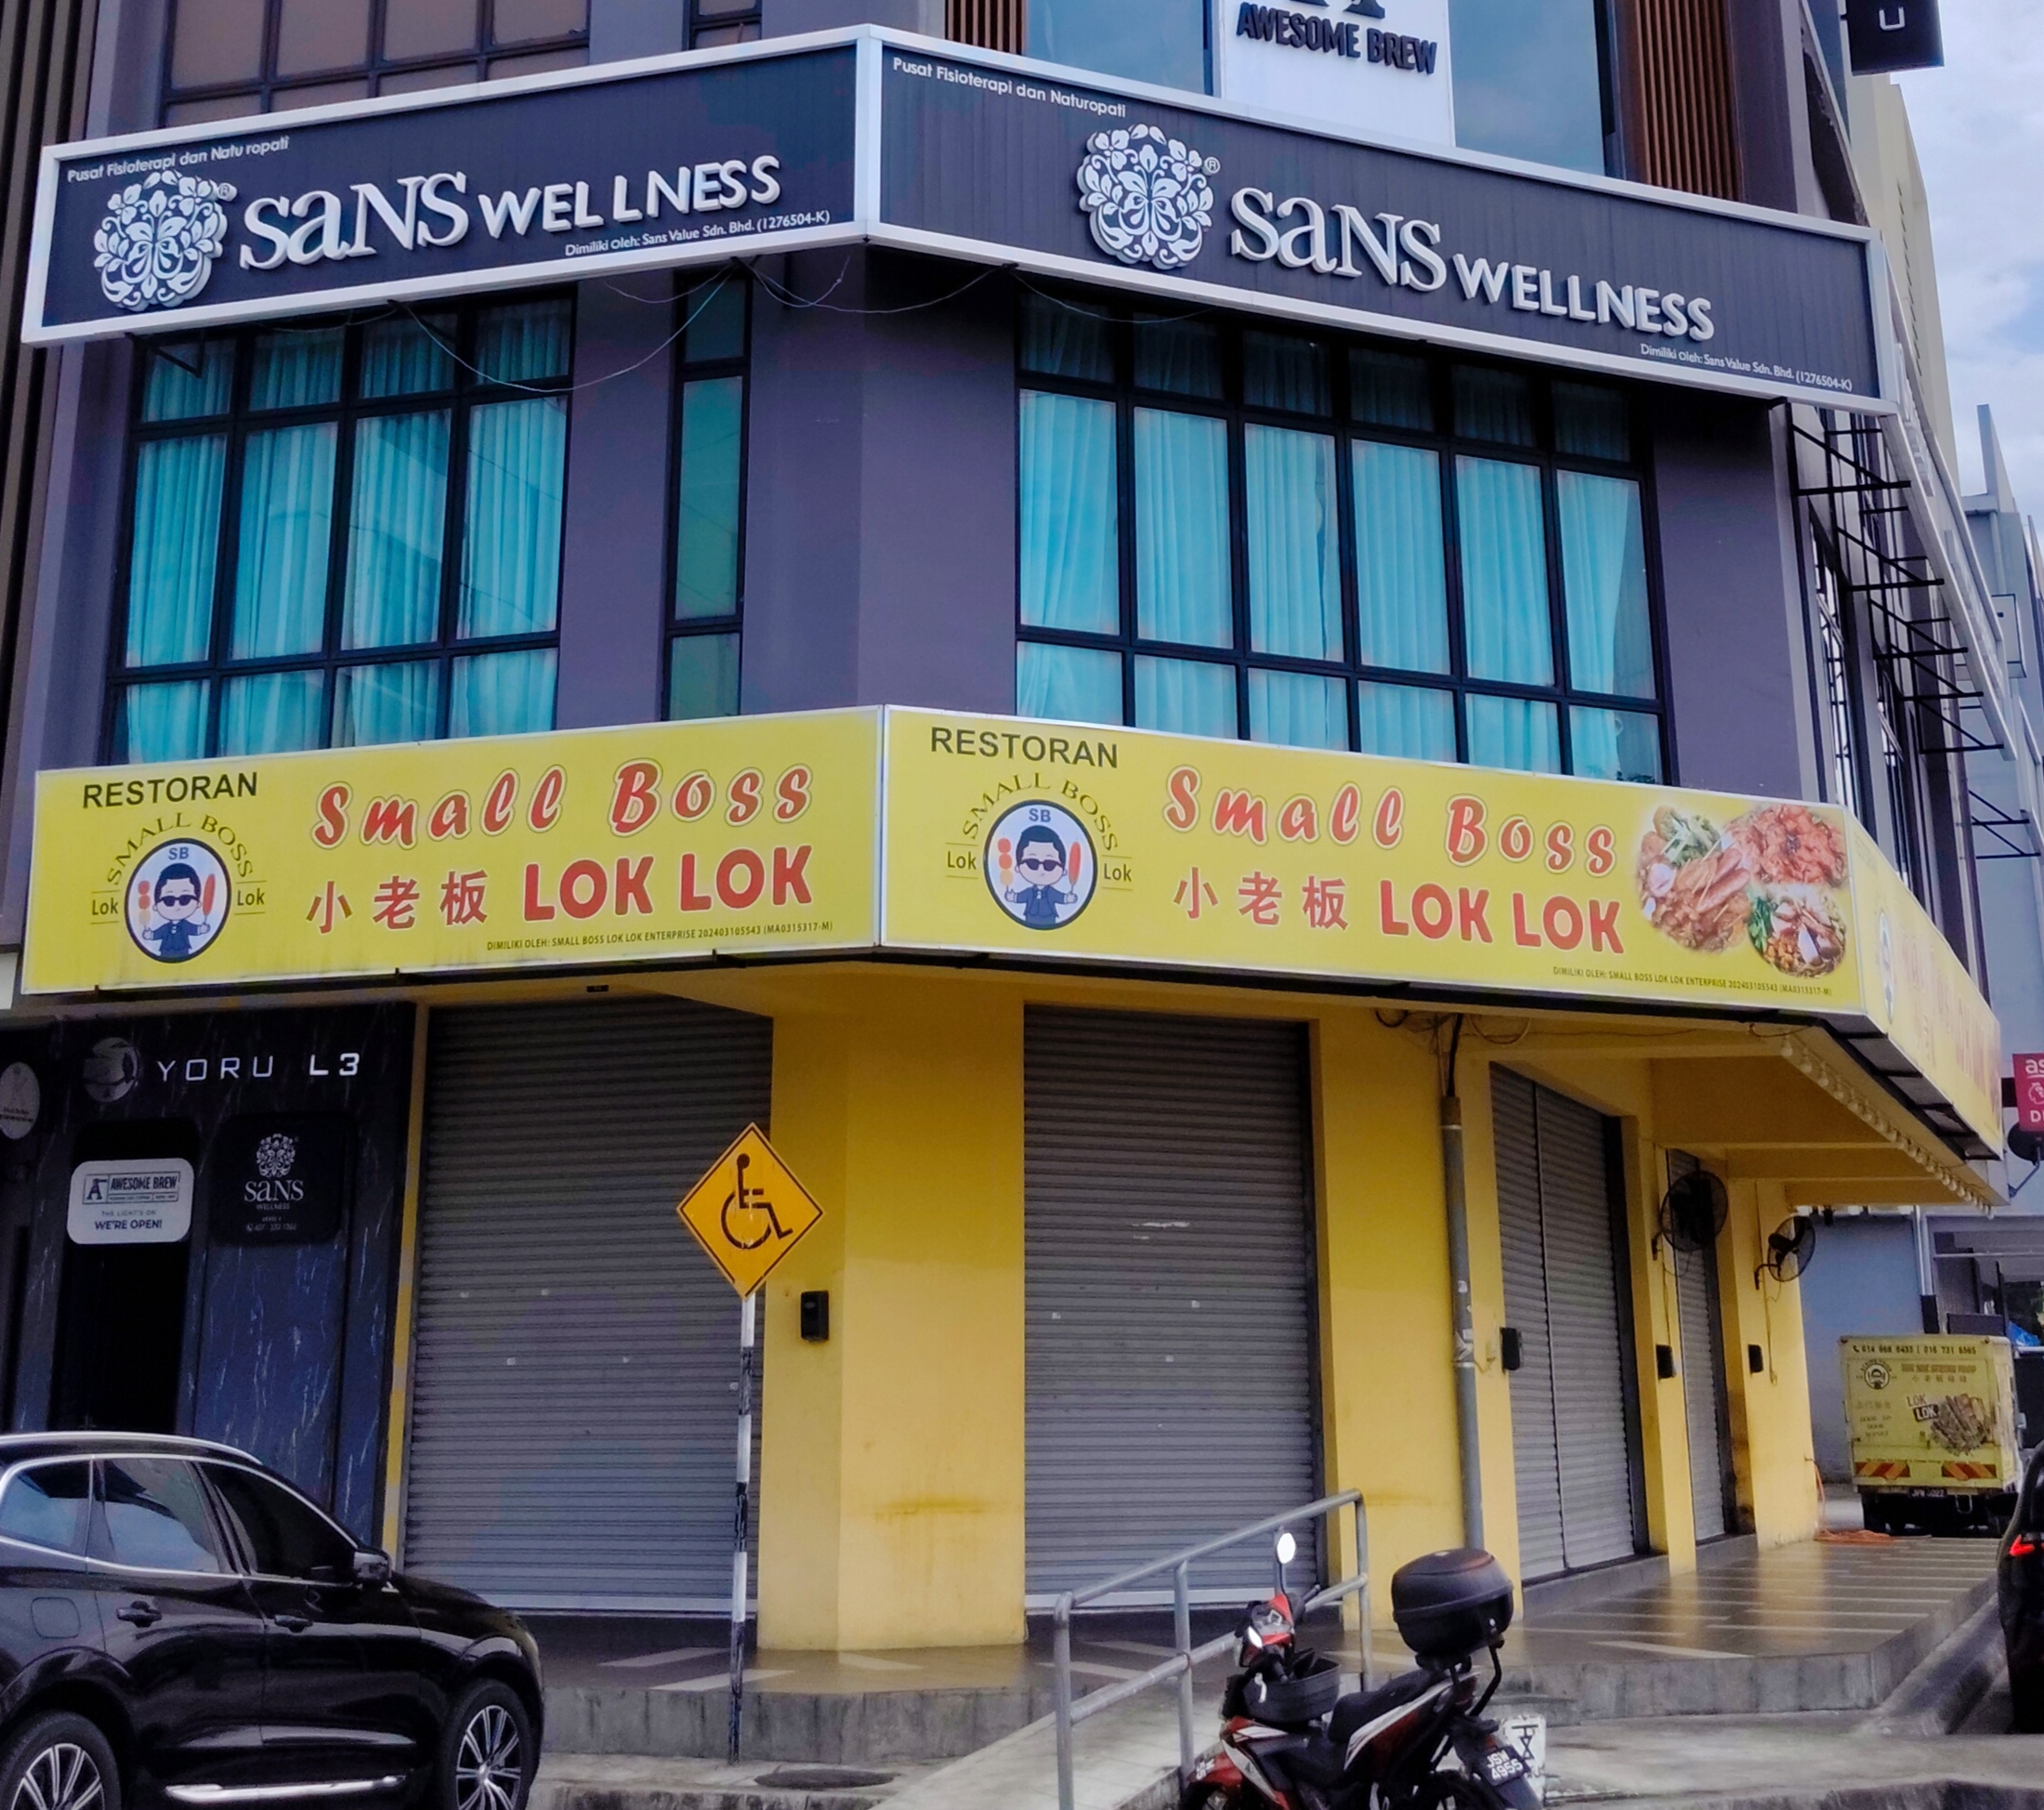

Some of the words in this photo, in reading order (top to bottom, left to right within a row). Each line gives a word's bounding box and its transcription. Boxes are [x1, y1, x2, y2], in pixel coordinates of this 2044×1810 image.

[1237, 2, 1361, 58] AWESOME
[1367, 27, 1437, 75] BREW
[893, 58, 932, 78] Pusat
[937, 66, 1013, 96] Fisioterapi
[1016, 84, 1046, 101] dan
[1051, 90, 1126, 118] Naturopati
[68, 164, 104, 182] Pusat
[107, 152, 176, 177] Fisioterapi
[179, 150, 208, 166] dan
[478, 154, 781, 239] WELLNESS
[565, 239, 609, 256] Dimiliki
[610, 236, 641, 251] Oleh:
[642, 232, 667, 246] Sans
[668, 229, 700, 243] Value
[702, 225, 727, 238] Sdn.
[728, 219, 754, 233] Bhd.
[756, 210, 831, 233] (1276504-K)
[1452, 253, 1715, 341] WELLNESS
[1640, 343, 1677, 360] Dimiliki
[1703, 353, 1725, 368] Sans
[1725, 357, 1750, 372] Value
[1752, 361, 1772, 375] Sdn.
[1774, 365, 1794, 379] Bhd.
[930, 727, 1118, 768] RESTORAN
[83, 771, 257, 808] RESTORAN
[312, 765, 566, 847] Small
[609, 759, 812, 836] Boss
[962, 772, 1051, 840] SMALL
[1061, 780, 1119, 850] BOSS
[1028, 808, 1051, 823] SB
[1164, 766, 1402, 848] Small
[1445, 794, 1616, 875] Boss
[107, 812, 191, 885] SMALL
[201, 814, 254, 877] BOSS
[168, 846, 190, 861] SB
[947, 850, 976, 870] Lok
[1103, 863, 1133, 883] Lok
[92, 897, 119, 915] Lok
[237, 887, 265, 906] Lok
[523, 856, 654, 922] LOK
[680, 845, 813, 912] LOK
[1380, 879, 1493, 943] LOK
[1512, 892, 1624, 954] LOK
[487, 939, 522, 951] DIMILIKI
[524, 938, 550, 949] OLEH:
[552, 936, 580, 947] SMALL
[583, 934, 604, 945] BOSS
[607, 933, 623, 944] LOK
[625, 932, 641, 943] LOK
[645, 928, 695, 942] ENTERPRISE
[698, 925, 761, 938] 202403105543
[764, 921, 832, 935] (MA0315317-M)
[1553, 966, 1583, 977] DIMILIKI
[1608, 971, 1632, 981] SMALL
[1634, 972, 1653, 982] BOSS
[1655, 973, 1669, 983] LOK
[1671, 975, 1684, 985] LOK
[1685, 977, 1727, 989] ENTERPRISE
[157, 1056, 273, 1082] YORU
[309, 1052, 360, 1076] L3
[111, 1176, 151, 1190] AWESOME
[152, 1175, 177, 1189] BREW
[95, 1219, 127, 1230] WE'RE
[1906, 1394, 1927, 1407] LOK
[1915, 1404, 1937, 1420] LOK
[1491, 1758, 1524, 1780] 4955
